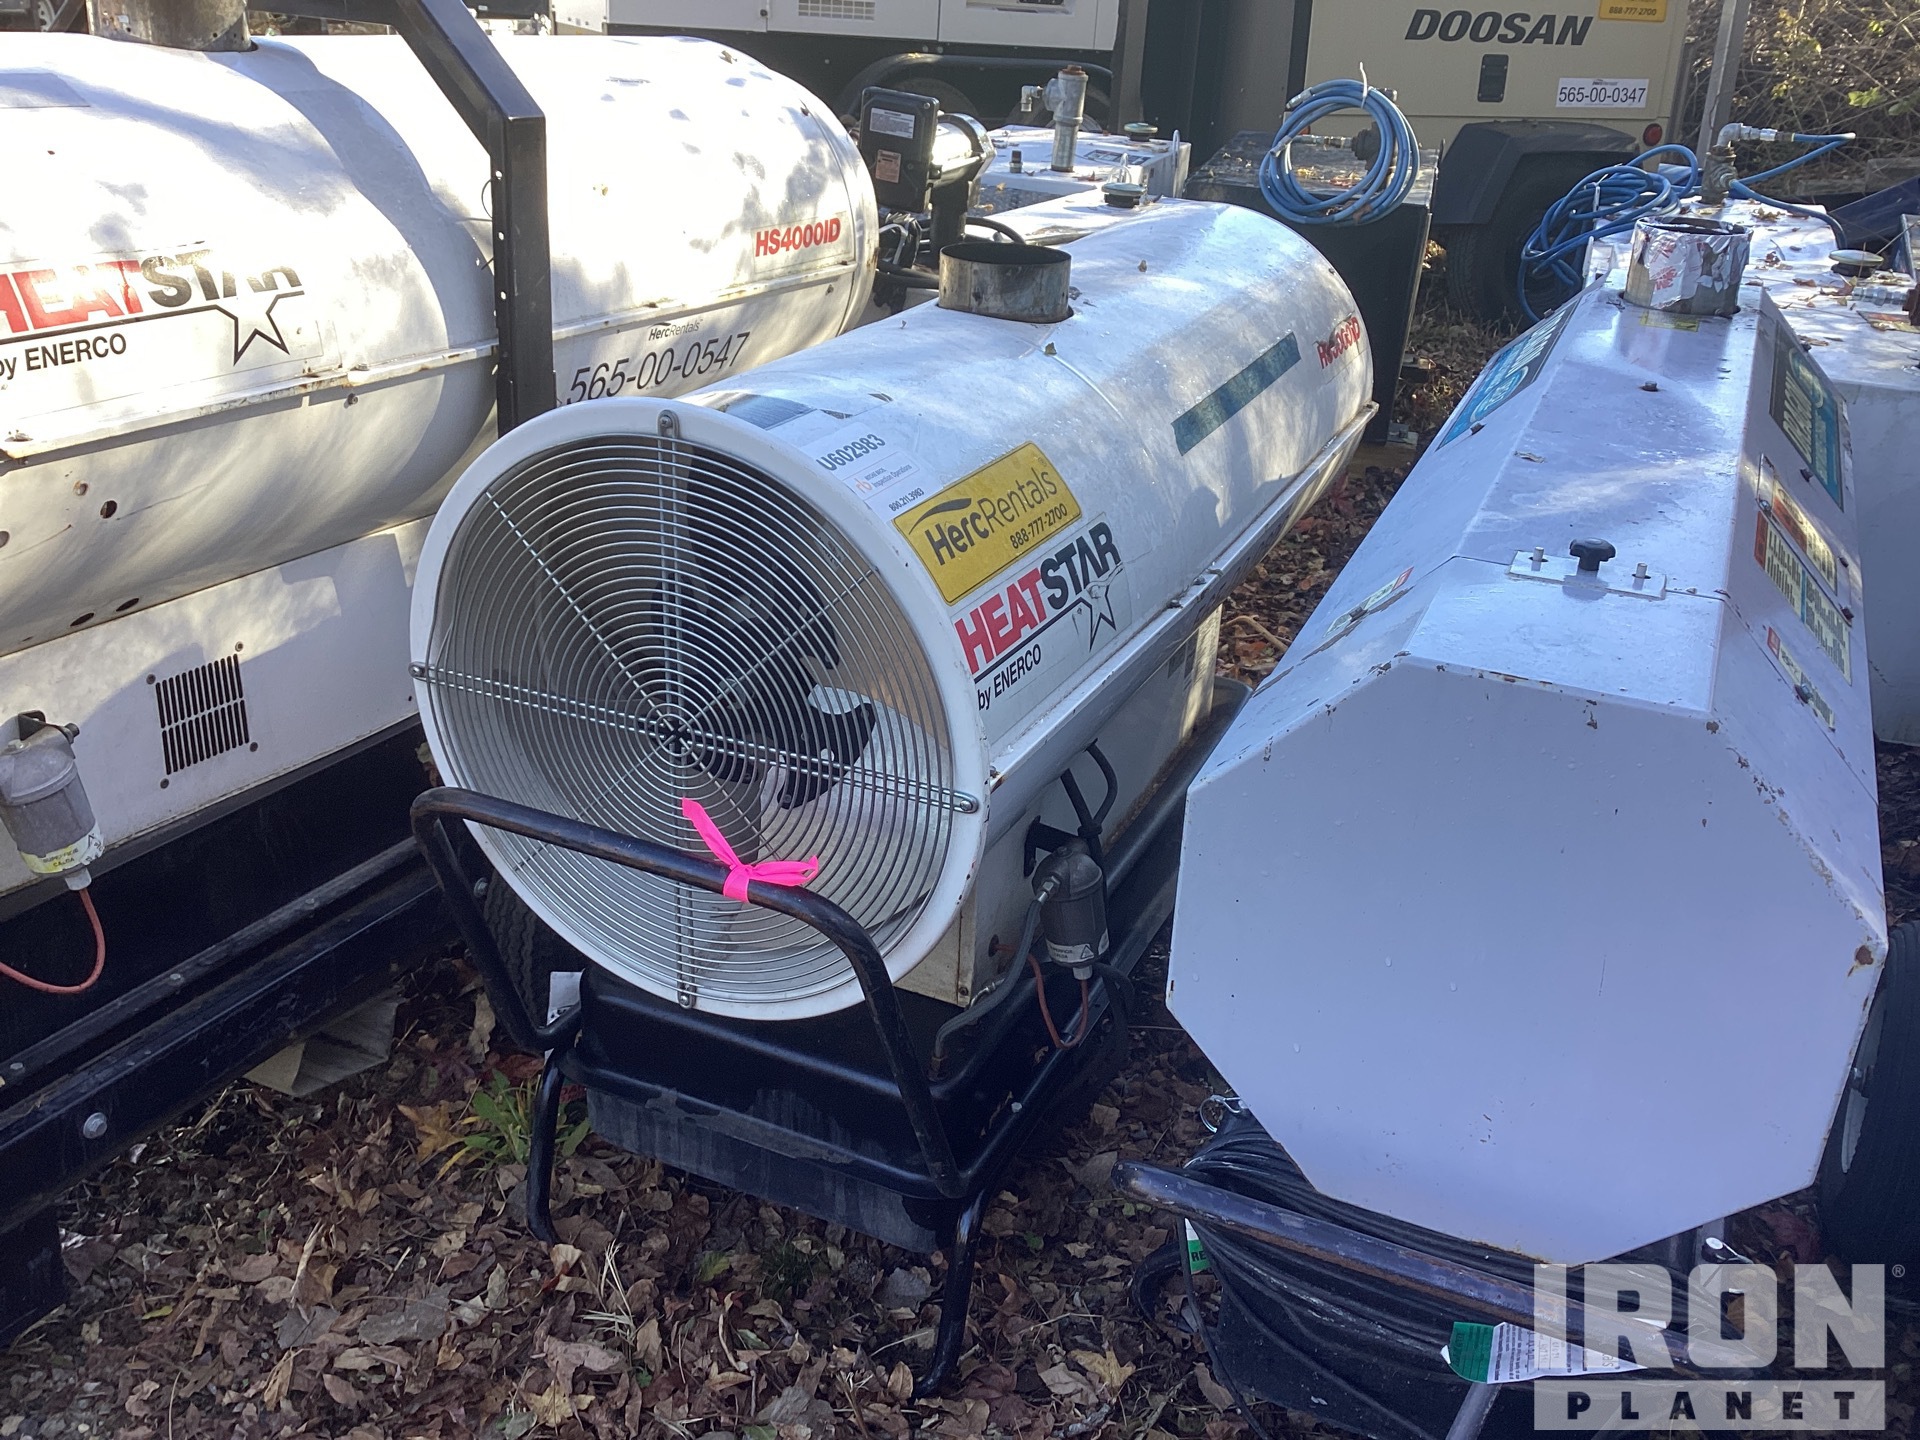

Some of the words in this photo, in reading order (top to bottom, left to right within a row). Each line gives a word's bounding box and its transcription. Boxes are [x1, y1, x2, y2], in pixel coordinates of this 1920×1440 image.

[1404, 9, 1594, 46] DOOSAN
[1558, 86, 1646, 103] 565-00-0347
[755, 217, 841, 257] HS4000ID
[648, 319, 702, 341] HercRentals
[25, 333, 127, 372] ENERCO
[566, 331, 751, 405] 565-00-0547
[815, 433, 886, 471] U602983
[888, 487, 925, 512] 800.211.3983
[924, 467, 1058, 566] HercRentals
[1009, 503, 1068, 549] 888-777-2700
[954, 521, 1122, 675] HEATSTAR
[977, 686, 991, 711] by
[993, 643, 1042, 698] ENERCO
